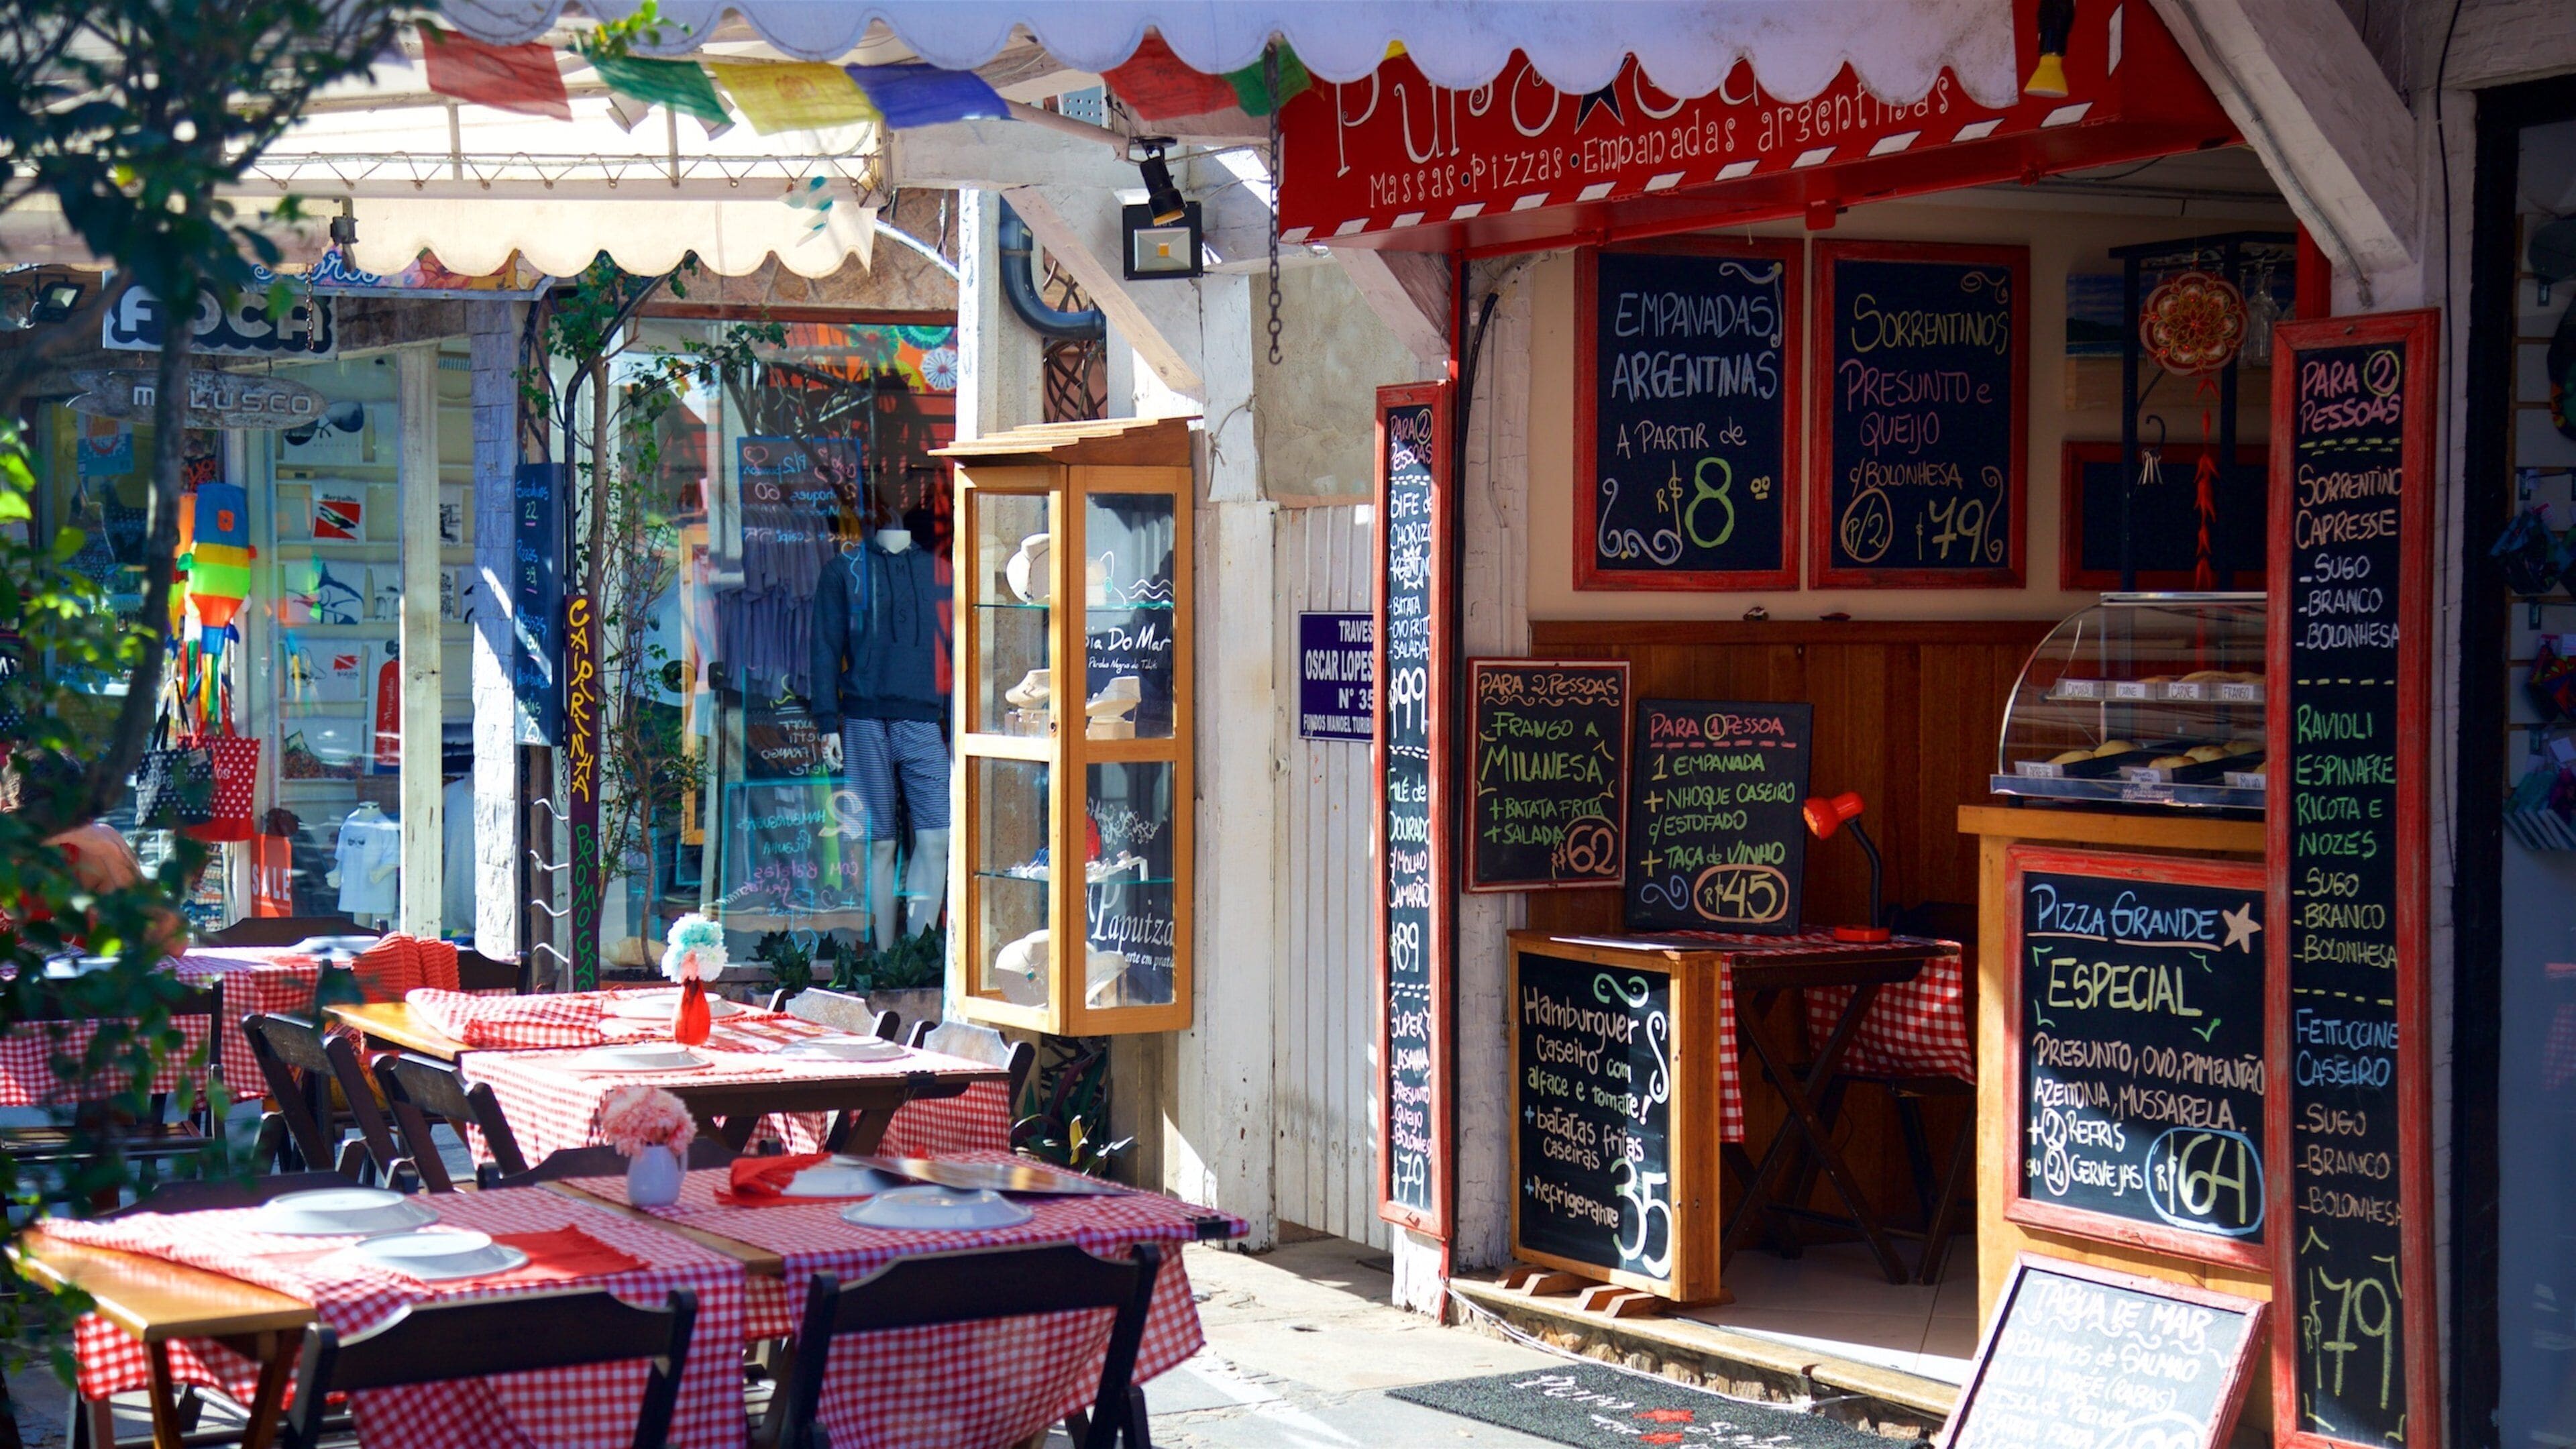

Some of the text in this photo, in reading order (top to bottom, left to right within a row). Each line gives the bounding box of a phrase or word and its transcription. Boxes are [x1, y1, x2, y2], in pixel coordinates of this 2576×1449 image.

[1583, 108, 1736, 174] Empanadas
[1615, 292, 1775, 337] EMPANADAS
[1851, 293, 2009, 356] SORRENTINOS
[1611, 350, 1778, 402] ARGENTINAS
[1839, 358, 1970, 413] PRESUNTO
[2301, 360, 2360, 401] PARA
[1389, 414, 1416, 441] PARA
[1616, 416, 1748, 460] A PARTIR de
[1860, 411, 1940, 456] QUEIJO
[1389, 489, 1420, 519] BIFE
[2294, 508, 2398, 550] CAPRESSE
[1305, 649, 1339, 681] OSCAR
[1479, 672, 1524, 698] PARA
[1531, 674, 1548, 695] 2
[1491, 711, 1599, 741] FRANGO A
[1650, 712, 1700, 741] PARA
[2298, 704, 2374, 745] RAVIOLI
[1481, 744, 1604, 786] MILANESA
[1651, 753, 1766, 782] 1 EMPANADA
[2294, 753, 2397, 787] ESPINAFRE
[1560, 798, 1605, 820] FRITA
[1735, 782, 1796, 805] CASEIRO
[2297, 791, 2383, 826] RICOTA E
[1726, 839, 1786, 866] VINHO
[2298, 830, 2378, 859] NOZES
[252, 863, 291, 902] SALE
[2031, 883, 2218, 941] PIZZA GRANDE
[2048, 957, 2203, 1016] ESPECIAL
[1523, 985, 1640, 1055] Hamburguer
[1527, 1065, 1569, 1097] alface
[2296, 1049, 2391, 1089] CASEIRO
[1609, 1157, 1672, 1279] 35
